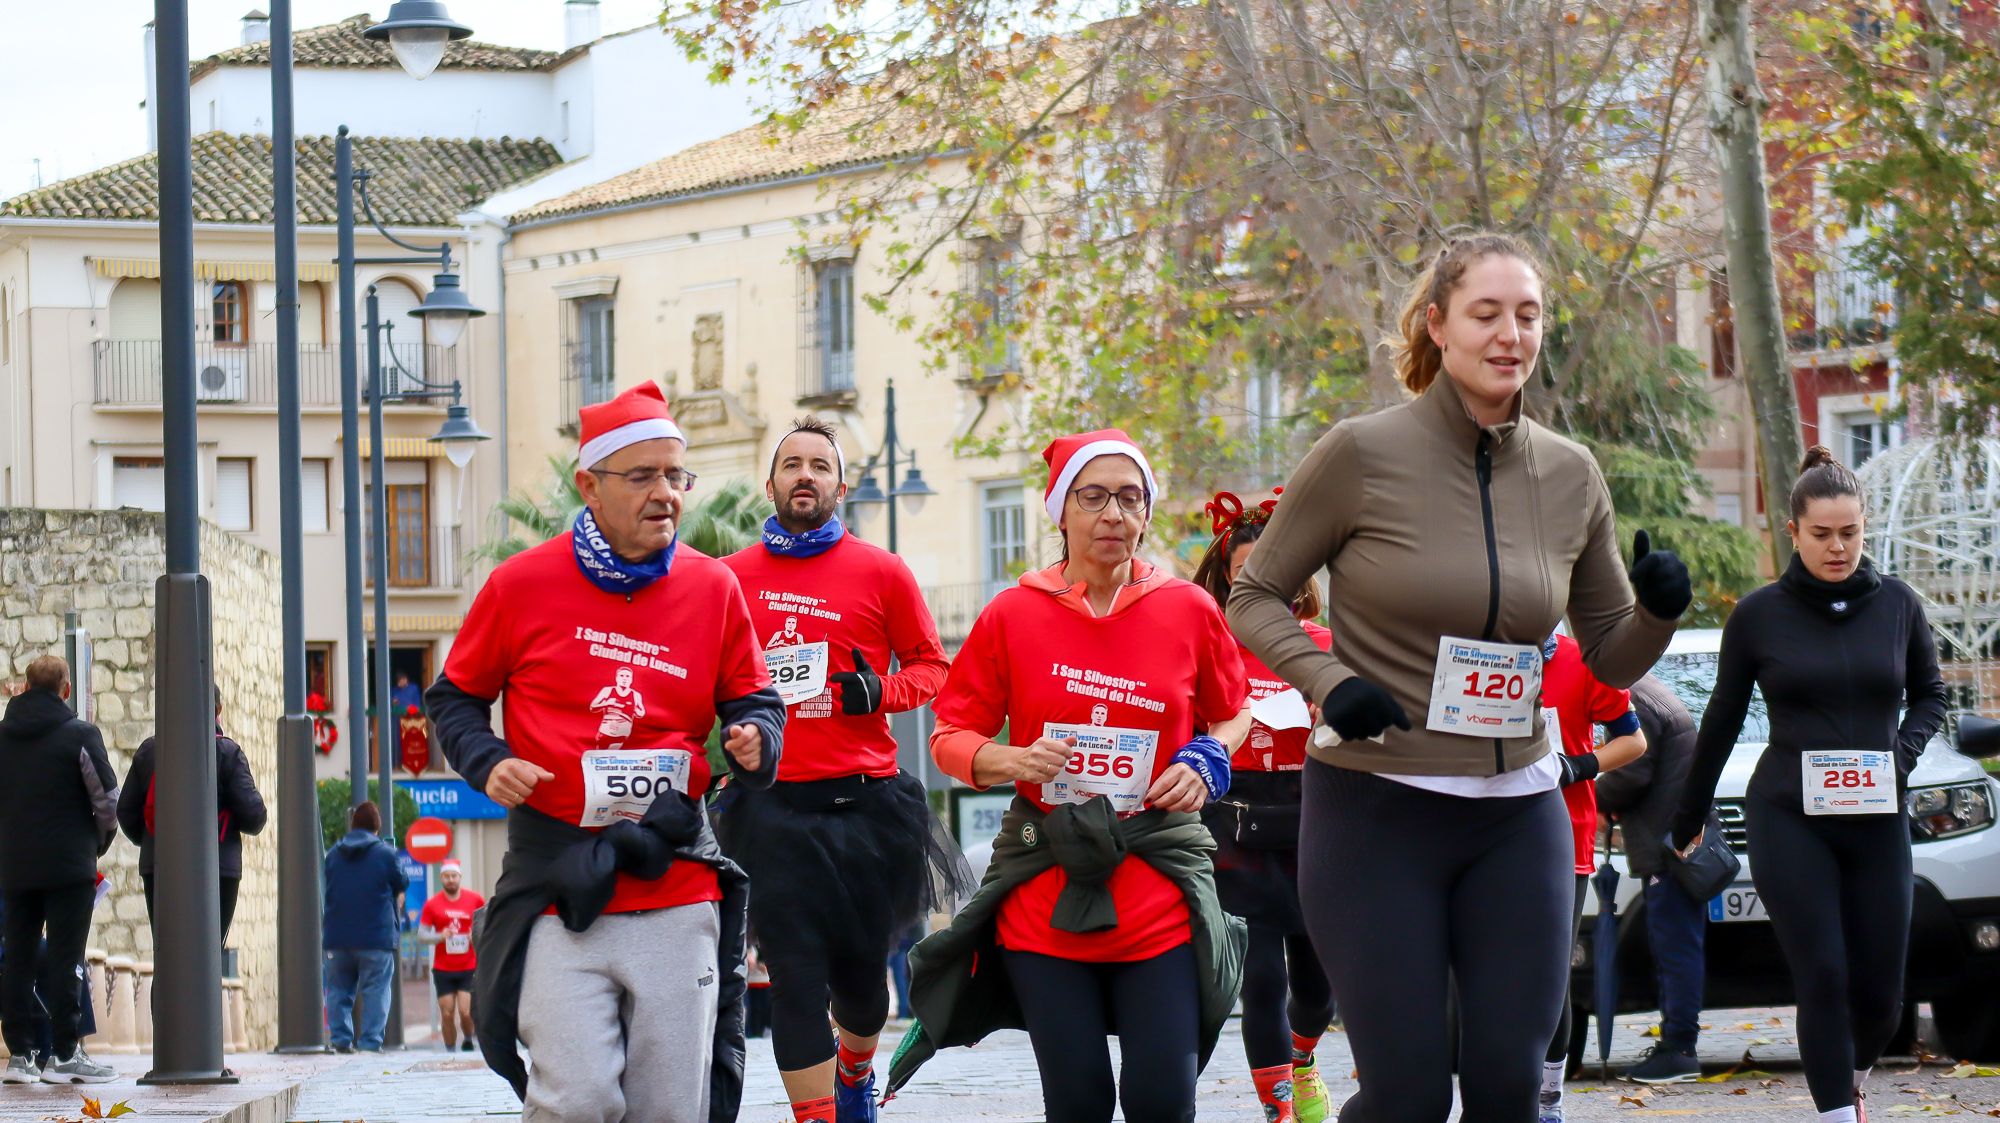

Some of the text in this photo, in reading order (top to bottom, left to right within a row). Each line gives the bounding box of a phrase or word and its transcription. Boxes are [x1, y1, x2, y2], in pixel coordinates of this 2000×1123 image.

[765, 591, 780, 600] San
[782, 592, 818, 606] Silvestre
[768, 601, 841, 621] Ciudad de Lucena
[575, 626, 660, 656] I San Silvestre
[590, 643, 688, 680] Ciudad de Lucena
[1452, 656, 1478, 666] Ciudad
[1480, 660, 1489, 668] de
[1454, 648, 1469, 656] San
[1052, 664, 1059, 676] I
[1060, 664, 1082, 680] San
[1084, 670, 1136, 690] Silvestre
[1462, 671, 1524, 700] 120
[800, 702, 832, 710] HURTADO
[1066, 680, 1166, 713] Ciudad de Lucena
[796, 710, 832, 718] MARJALIZO
[1064, 752, 1134, 778] 356
[607, 776, 672, 798] 500
[1824, 770, 1876, 788] 281
